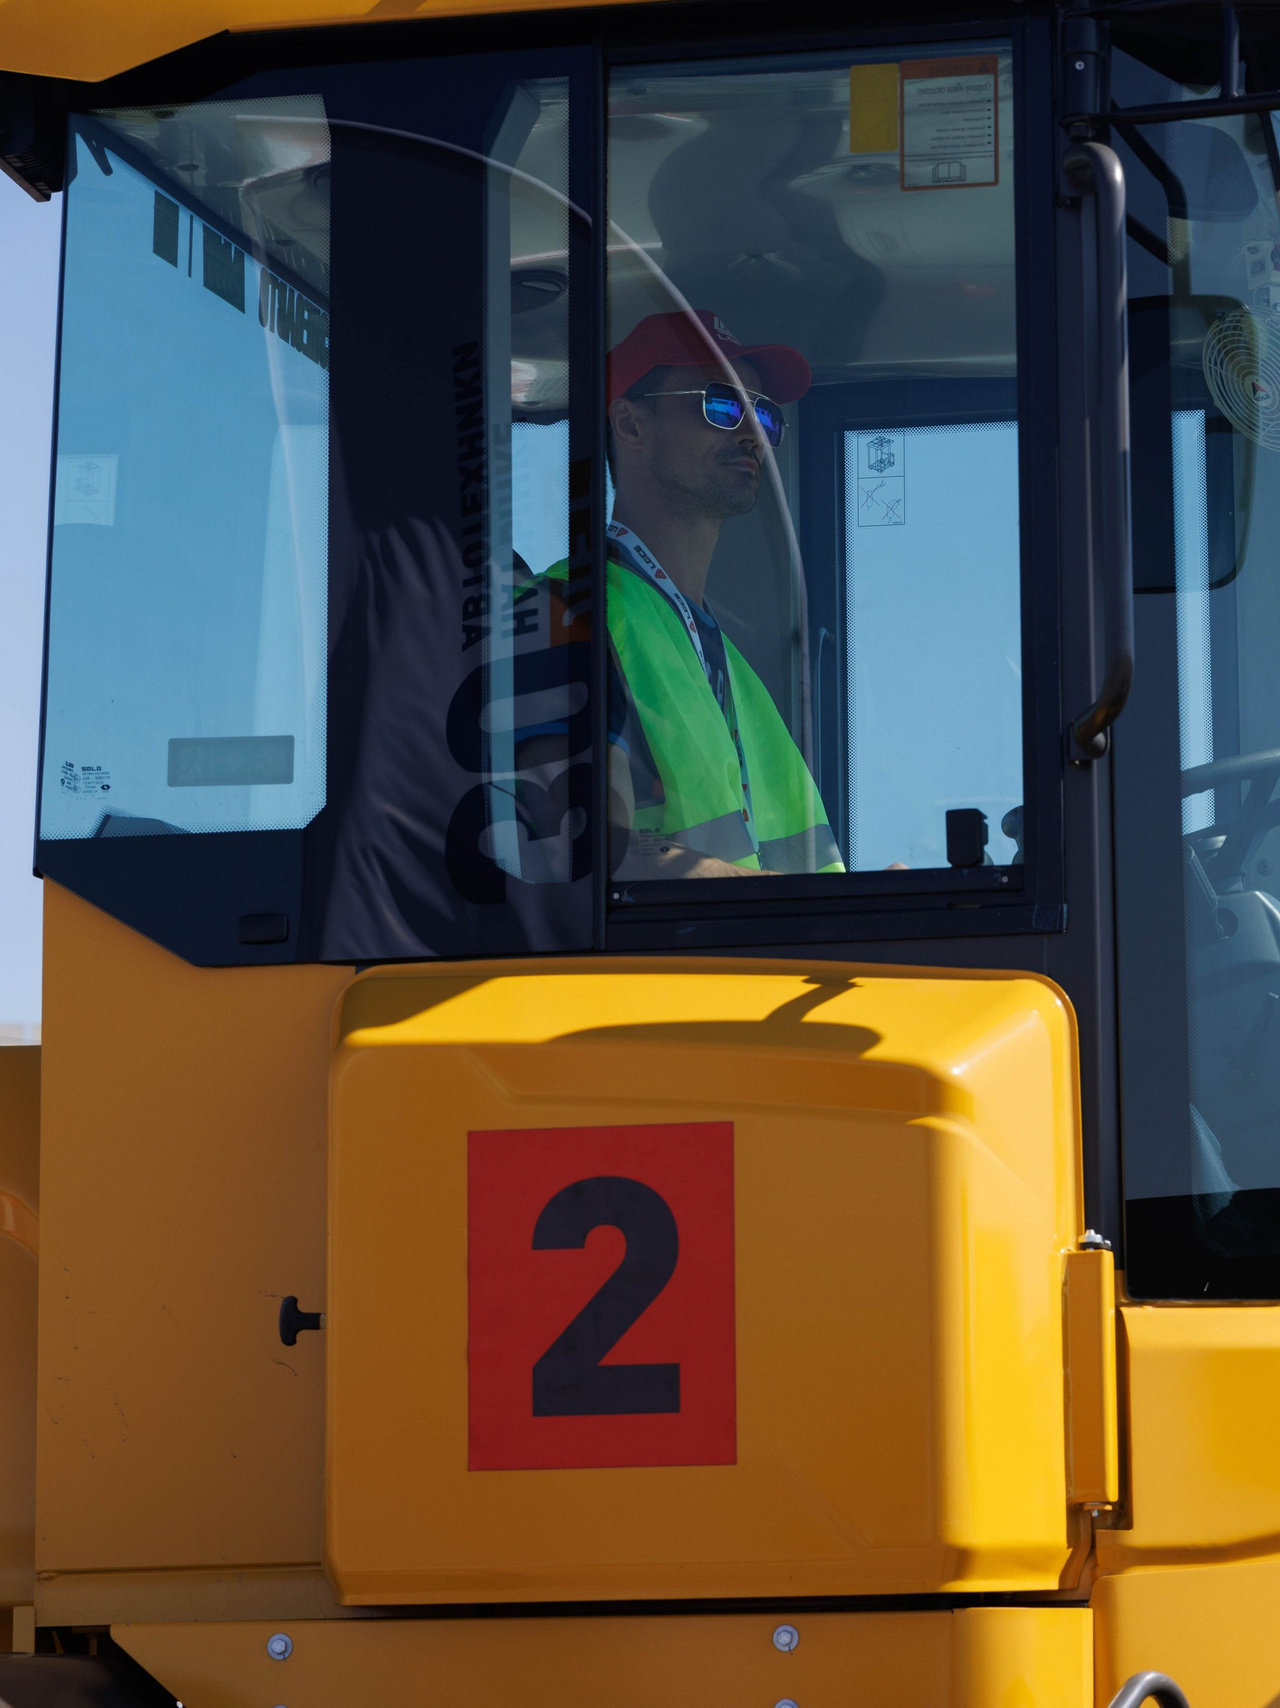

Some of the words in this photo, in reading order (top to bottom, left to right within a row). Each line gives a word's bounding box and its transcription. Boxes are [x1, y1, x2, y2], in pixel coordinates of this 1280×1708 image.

[633, 544, 656, 570] LGCE
[673, 592, 691, 620] LGCE
[531, 1176, 681, 1417] 2
